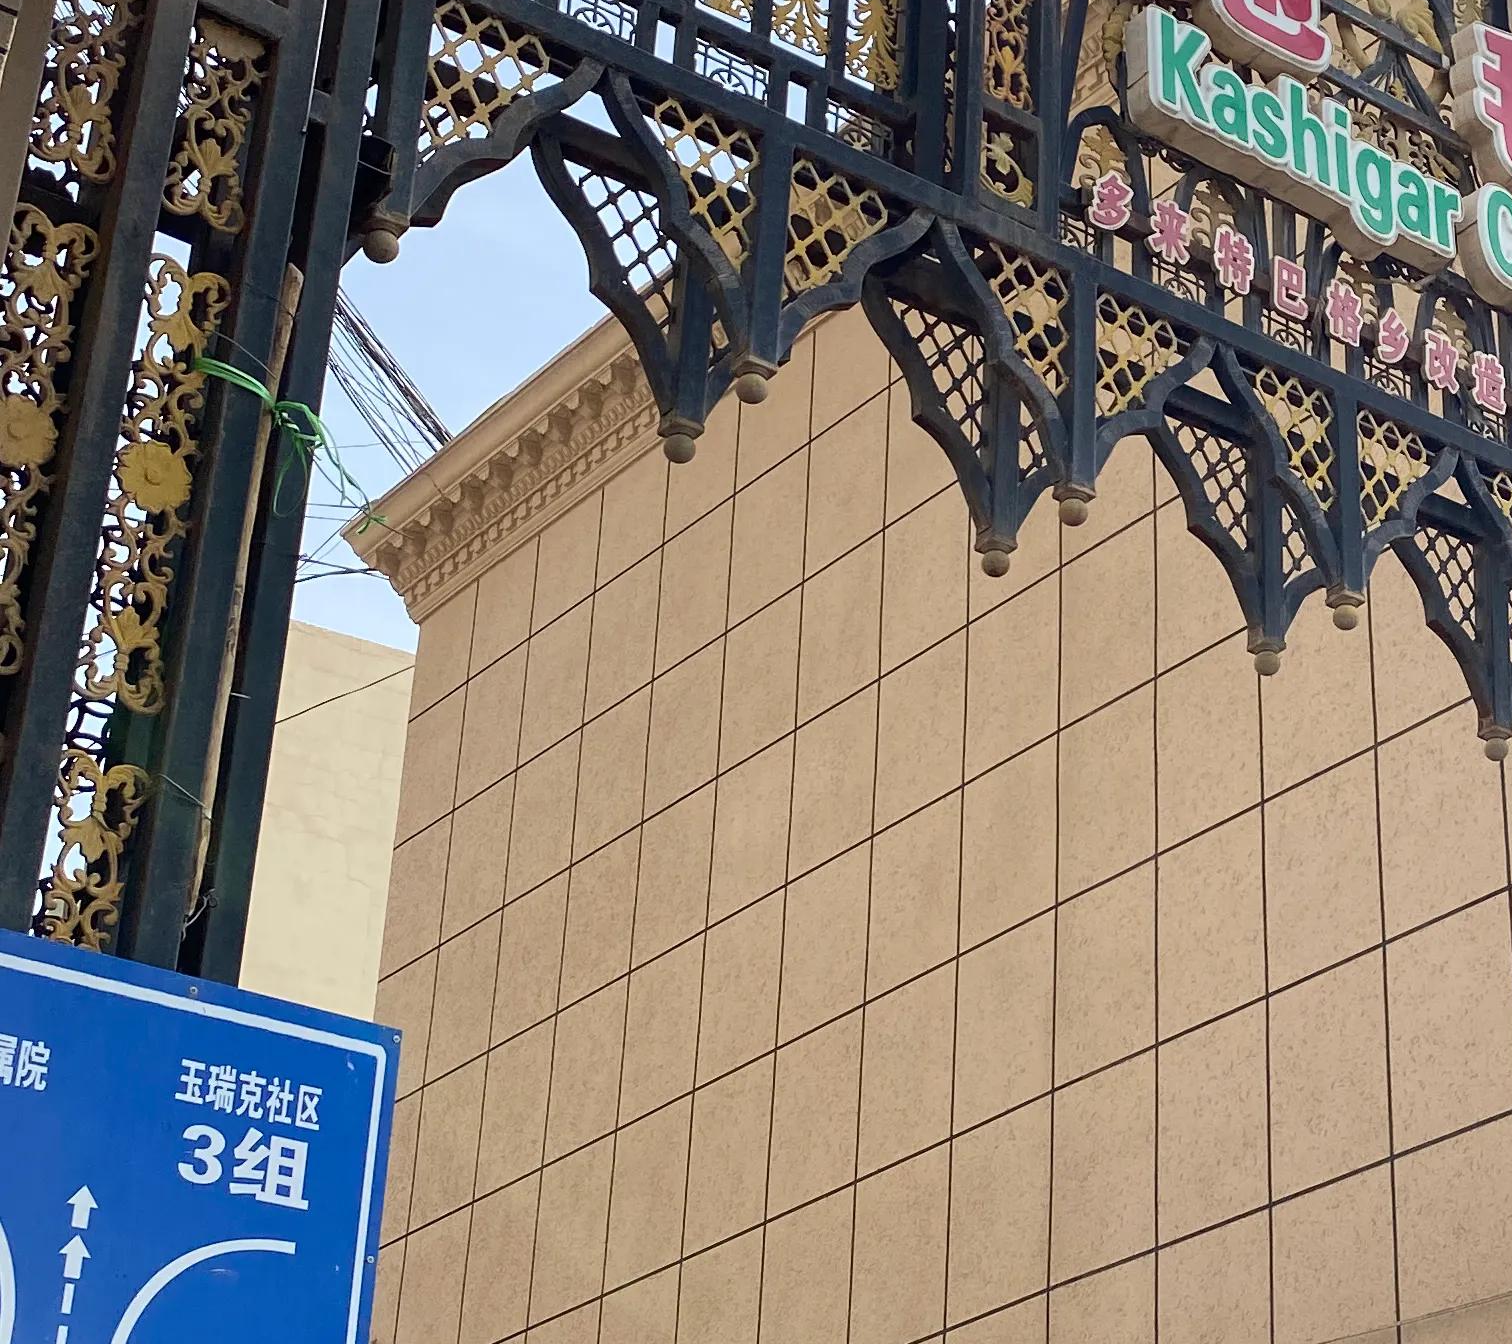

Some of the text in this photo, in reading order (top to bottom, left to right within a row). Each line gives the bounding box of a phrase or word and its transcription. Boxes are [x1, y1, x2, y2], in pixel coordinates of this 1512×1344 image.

[1153, 8, 1463, 256] Kashigar
[1089, 170, 1507, 414] 多来特巴格乡改造
[174, 1057, 322, 1131] 玉瑞克社区
[177, 1124, 311, 1212] 3组
